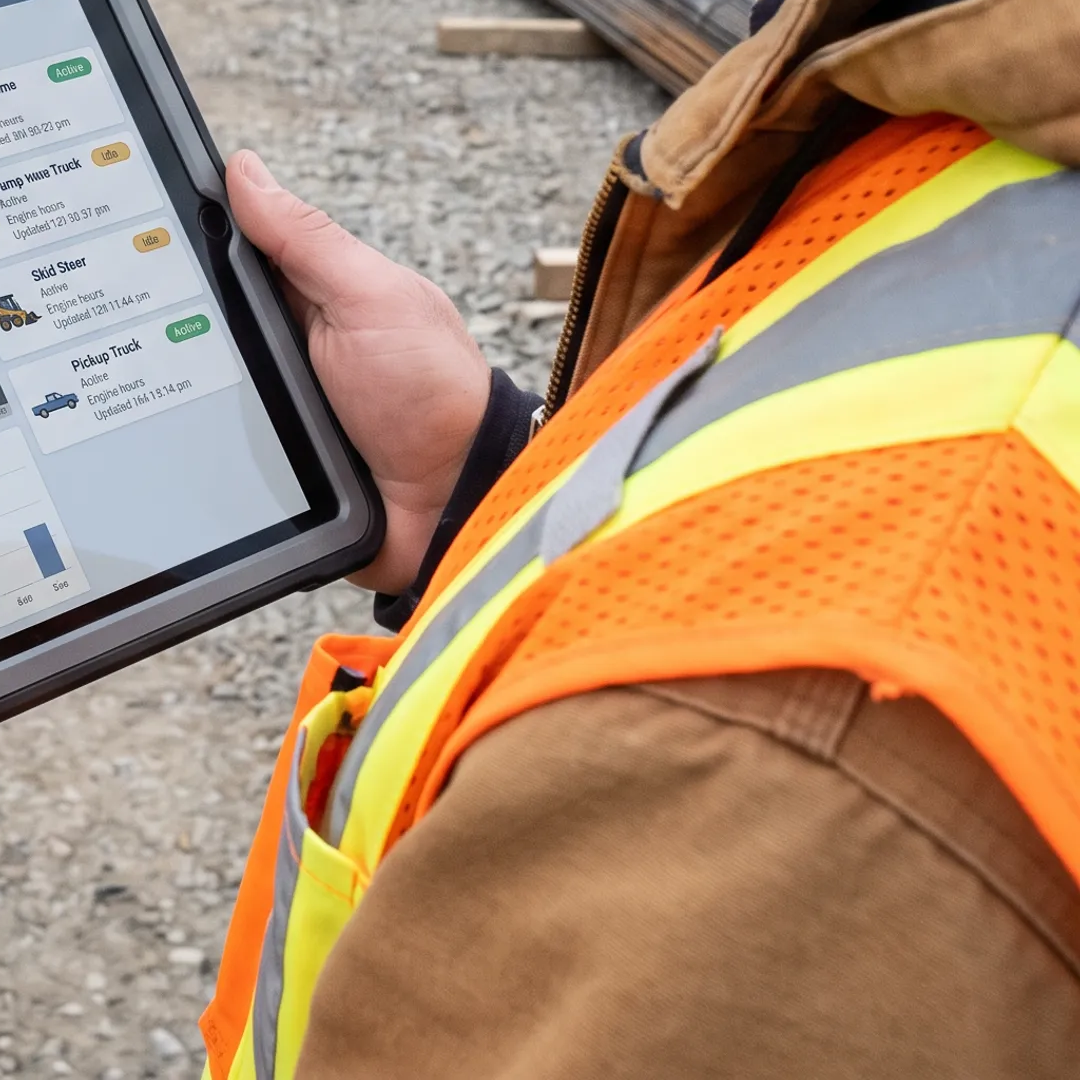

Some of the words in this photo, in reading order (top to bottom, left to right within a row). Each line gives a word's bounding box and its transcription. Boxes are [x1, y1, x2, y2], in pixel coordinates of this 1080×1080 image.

[50, 157, 83, 176] Truck
[31, 263, 57, 282] Skid
[57, 256, 87, 274] Steer
[46, 297, 78, 315] Engine
[71, 351, 110, 372] Pickup
[109, 338, 143, 358] Truck
[86, 386, 119, 406] Engine
[119, 377, 146, 395] hours
[176, 378, 193, 393] pm
